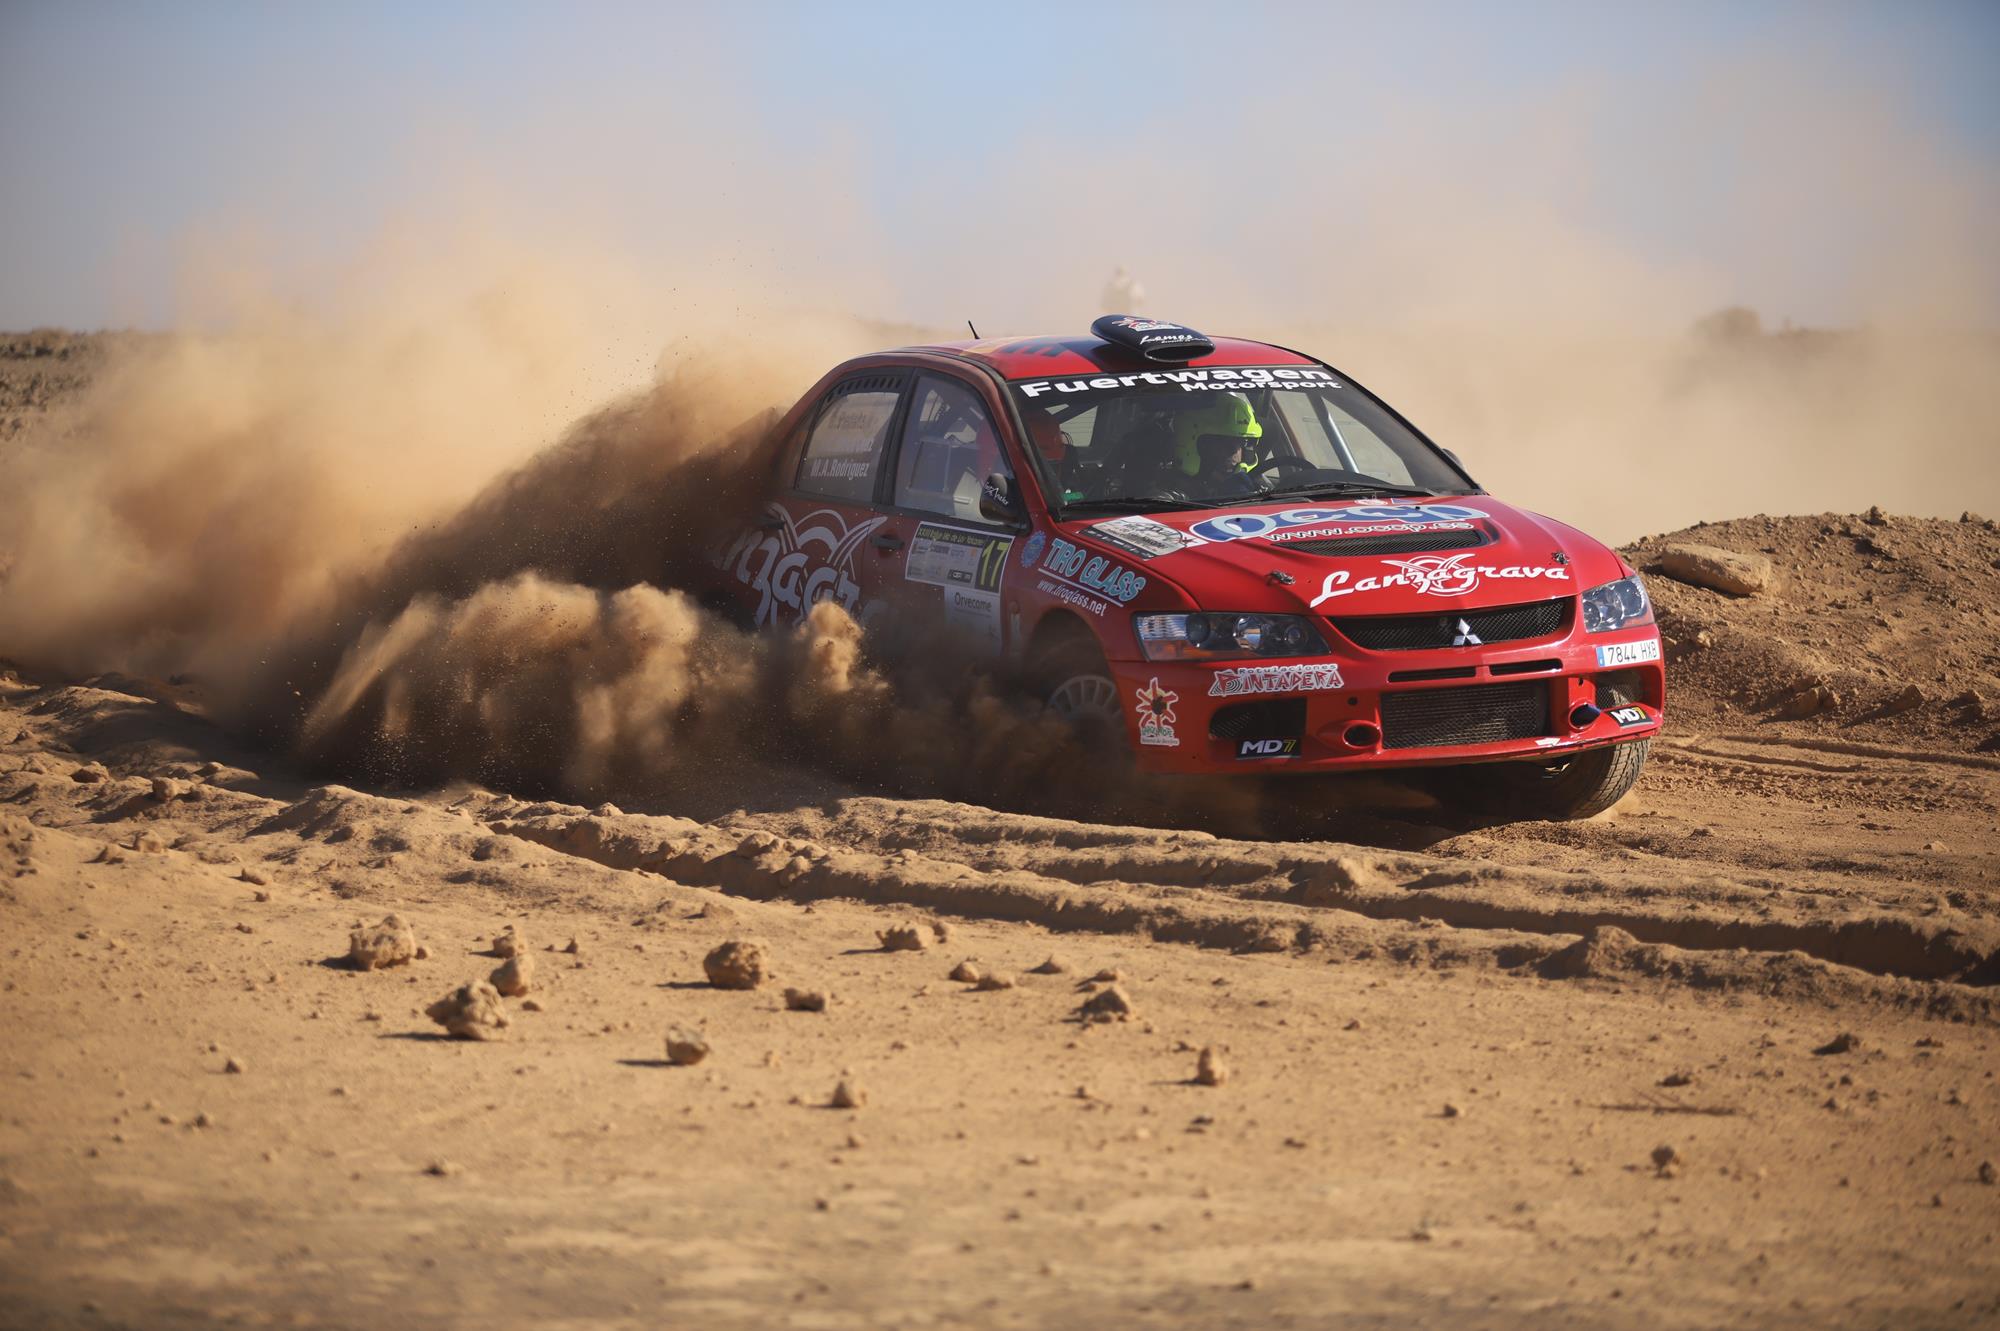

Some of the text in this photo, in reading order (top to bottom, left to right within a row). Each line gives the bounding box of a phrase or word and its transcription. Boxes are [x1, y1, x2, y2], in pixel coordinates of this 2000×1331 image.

[1020, 368, 1333, 398] Fuertwagen
[1181, 380, 1342, 393] Motorsport
[980, 539, 1010, 588] 17
[1043, 538, 1087, 577] TIRO
[1079, 556, 1147, 602] GLASS
[1037, 579, 1108, 617] www.tiroglass.net
[1310, 564, 1570, 608] Lanzagrava
[1608, 645, 1637, 664] 7844
[1239, 665, 1337, 674] Rotulaciones
[1211, 670, 1343, 695] PINTADERA
[1610, 706, 1646, 723] MD7
[1241, 739, 1297, 755] MD7
